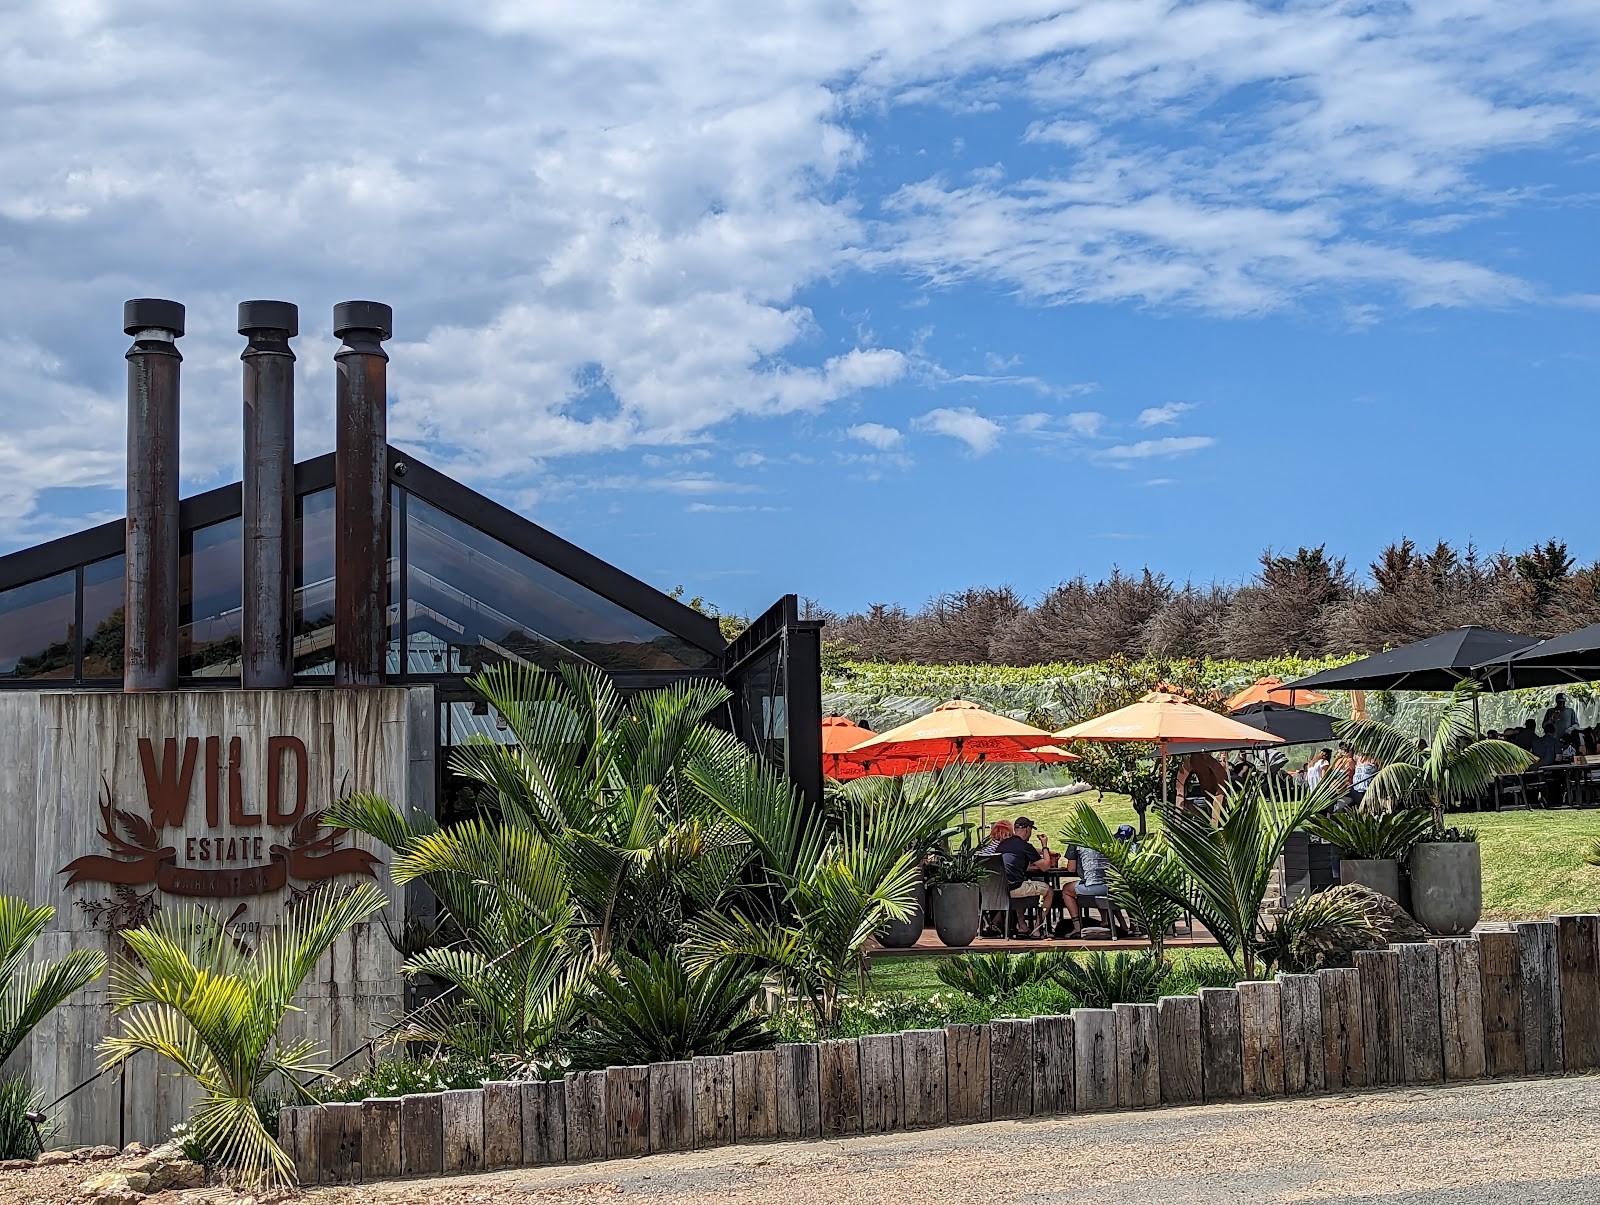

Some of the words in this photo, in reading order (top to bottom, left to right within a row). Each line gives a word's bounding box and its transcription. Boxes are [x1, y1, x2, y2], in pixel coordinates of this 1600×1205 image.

[138, 736, 309, 828] WILD
[186, 837, 263, 861] ESTATE
[234, 921, 260, 934] 2007
